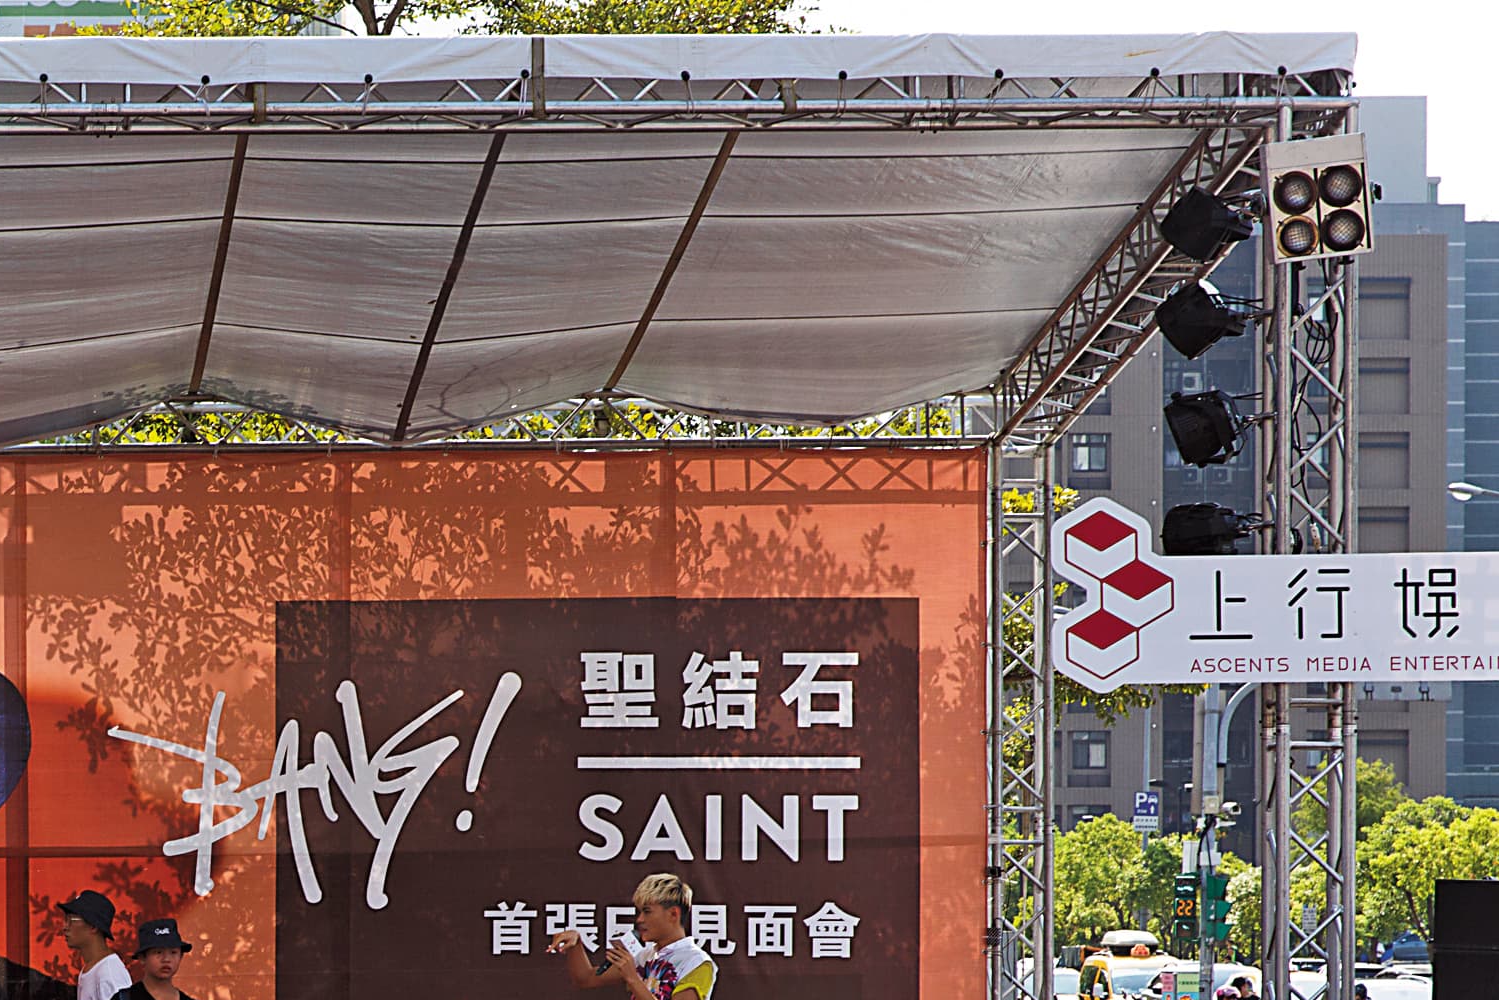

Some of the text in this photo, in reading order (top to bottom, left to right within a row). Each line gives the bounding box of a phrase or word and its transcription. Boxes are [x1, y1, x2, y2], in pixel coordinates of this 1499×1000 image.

[580, 651, 860, 730] 聖結石
[1190, 655, 1499, 673] ASCENTS MEDIA ENTERTAI
[106, 670, 523, 912] BANG!
[577, 793, 860, 863] SAINT
[1176, 900, 1194, 916] 22
